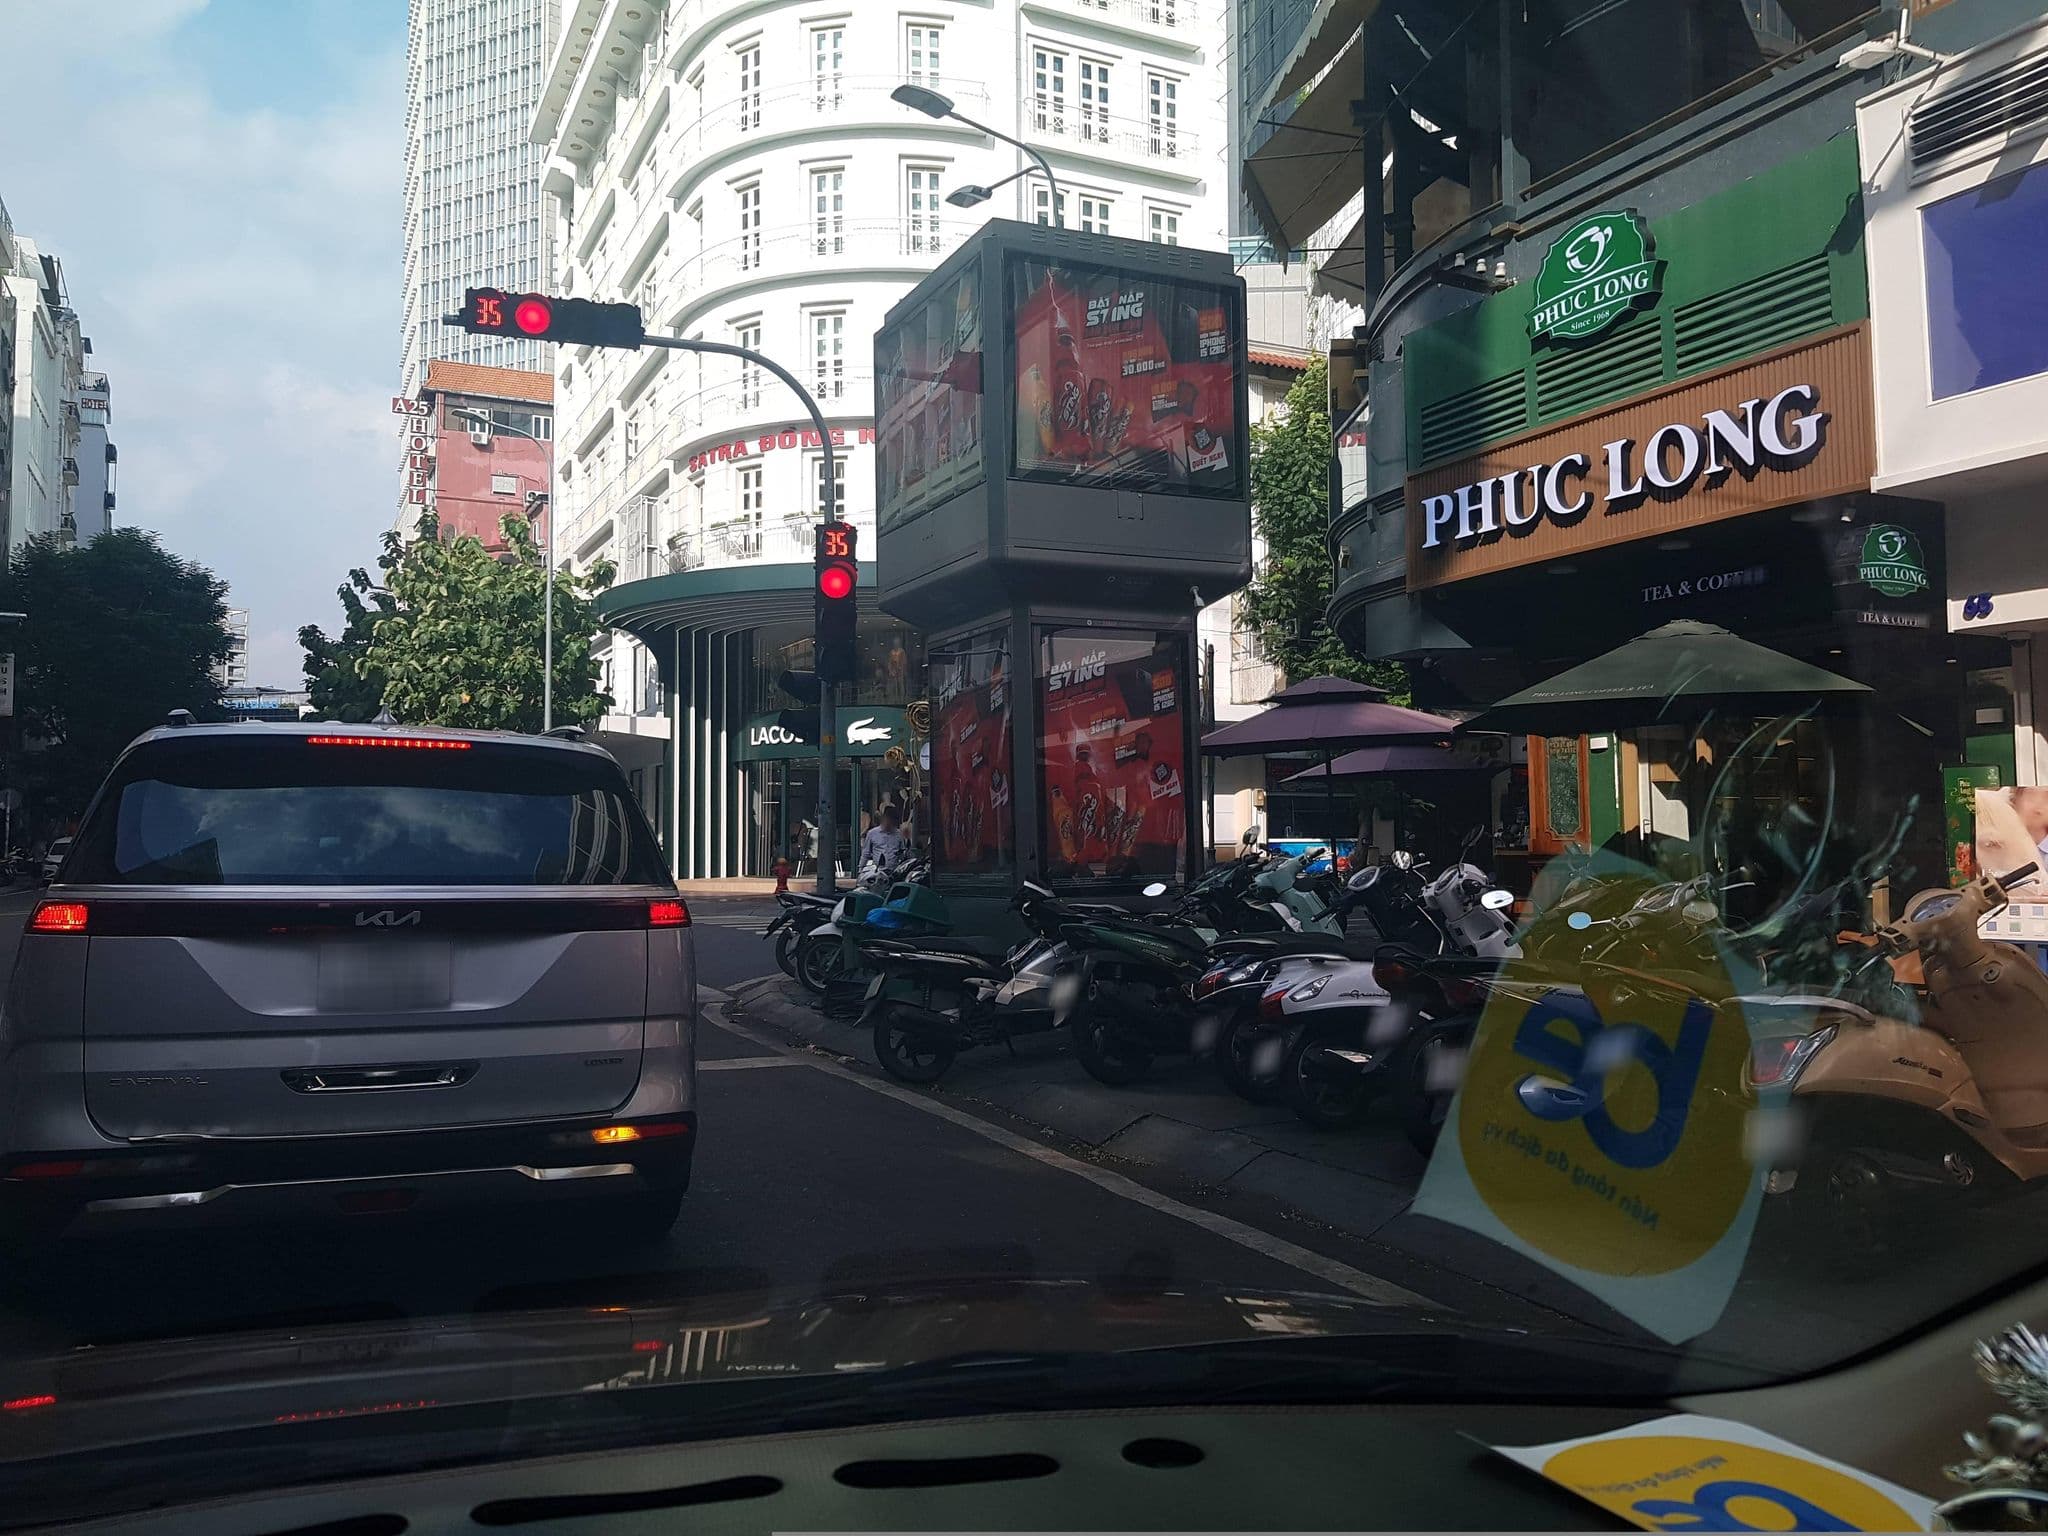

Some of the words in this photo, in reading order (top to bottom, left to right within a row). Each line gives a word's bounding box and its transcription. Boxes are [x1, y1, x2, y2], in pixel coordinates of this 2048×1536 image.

[476, 297, 501, 326] 35
[1533, 290, 1587, 332] PHUC
[1593, 269, 1649, 304] LONG
[1085, 302, 1144, 327] STING
[1570, 319, 1591, 331] Since
[1593, 310, 1610, 323] 1968
[394, 400, 429, 416] A25
[411, 418, 428, 503] HOTEL
[688, 440, 748, 473] SATRA
[1421, 453, 1588, 549] PHUC
[1602, 384, 1823, 502] LONG
[826, 532, 848, 555] 35
[1860, 566, 1891, 580] PHUC
[1894, 568, 1926, 585] LONG
[1641, 584, 1674, 602] TEA
[1678, 580, 1691, 595] &
[1049, 661, 1106, 692] STING
[355, 910, 421, 927] KIA
